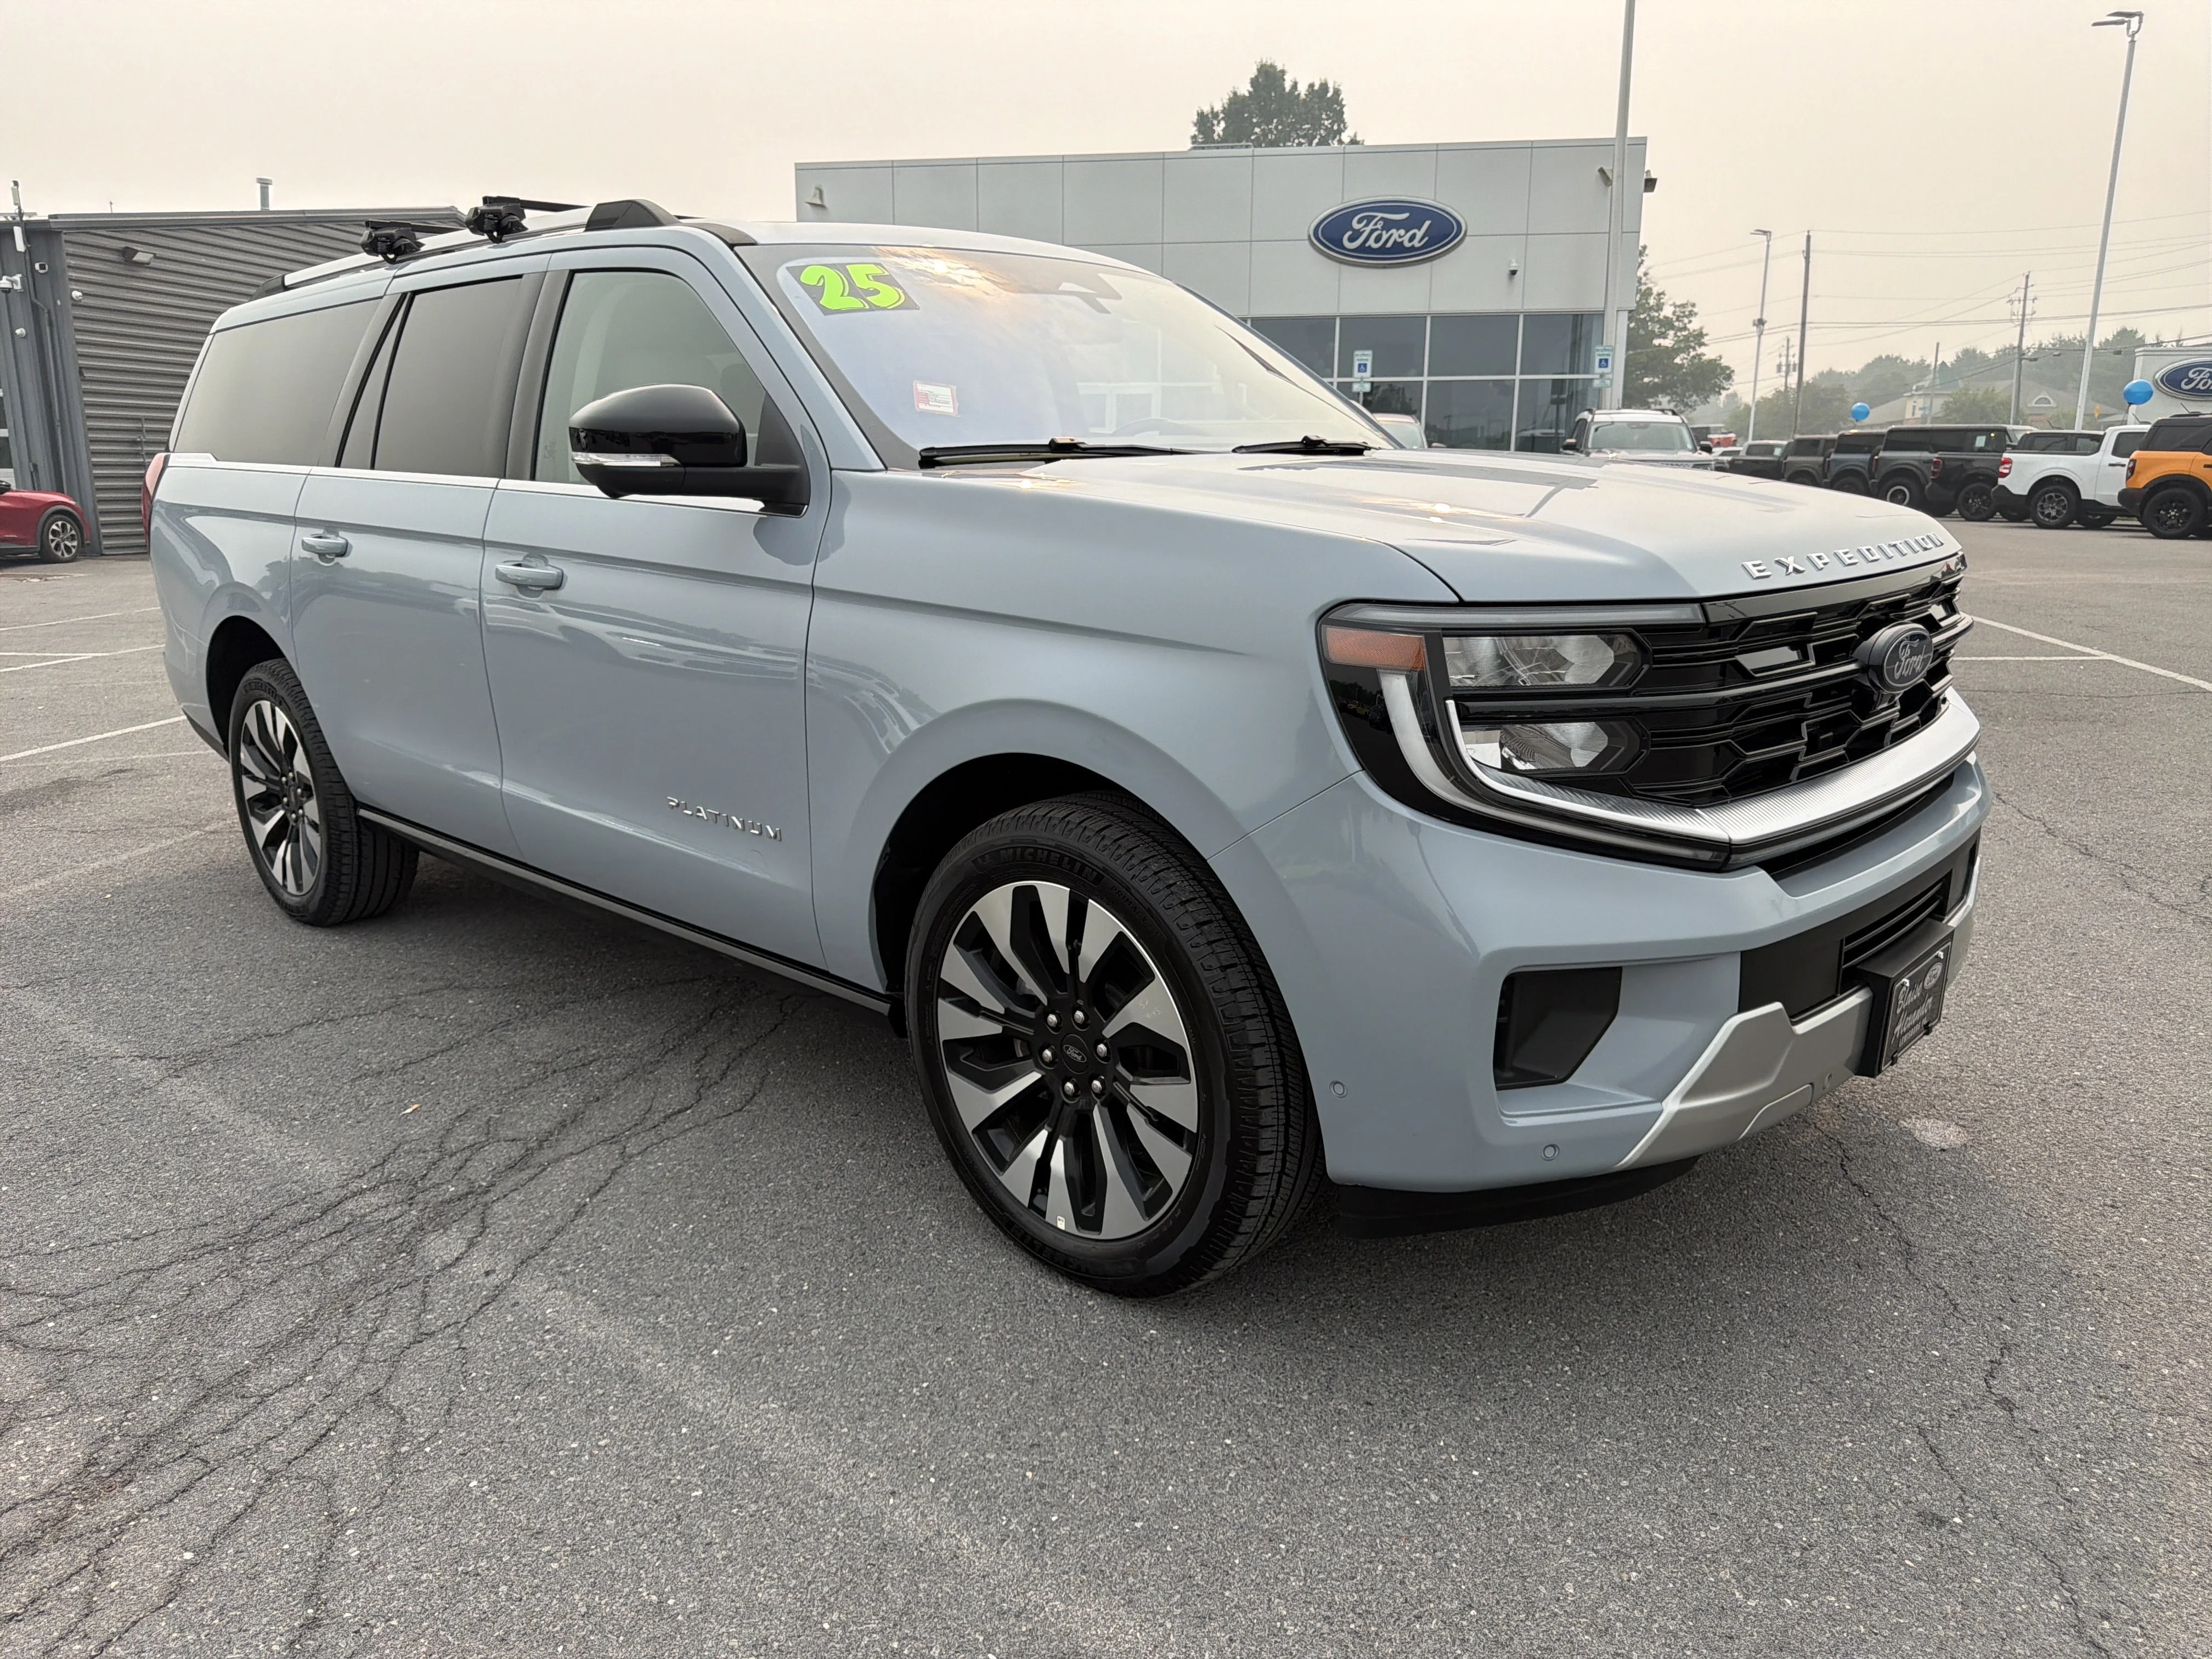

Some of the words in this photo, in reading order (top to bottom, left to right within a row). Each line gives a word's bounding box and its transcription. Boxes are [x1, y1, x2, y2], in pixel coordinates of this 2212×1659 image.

[1342, 212, 1432, 249] Ford
[800, 263, 906, 311] 25
[1741, 532, 1945, 580] EXPEDITION
[1894, 640, 1926, 680] Ford
[667, 796, 782, 842] PLATINUM
[1000, 848, 1098, 883] MICHELIN
[1110, 885, 1148, 922] PRIMACY
[1066, 1047, 1083, 1061] Ford
